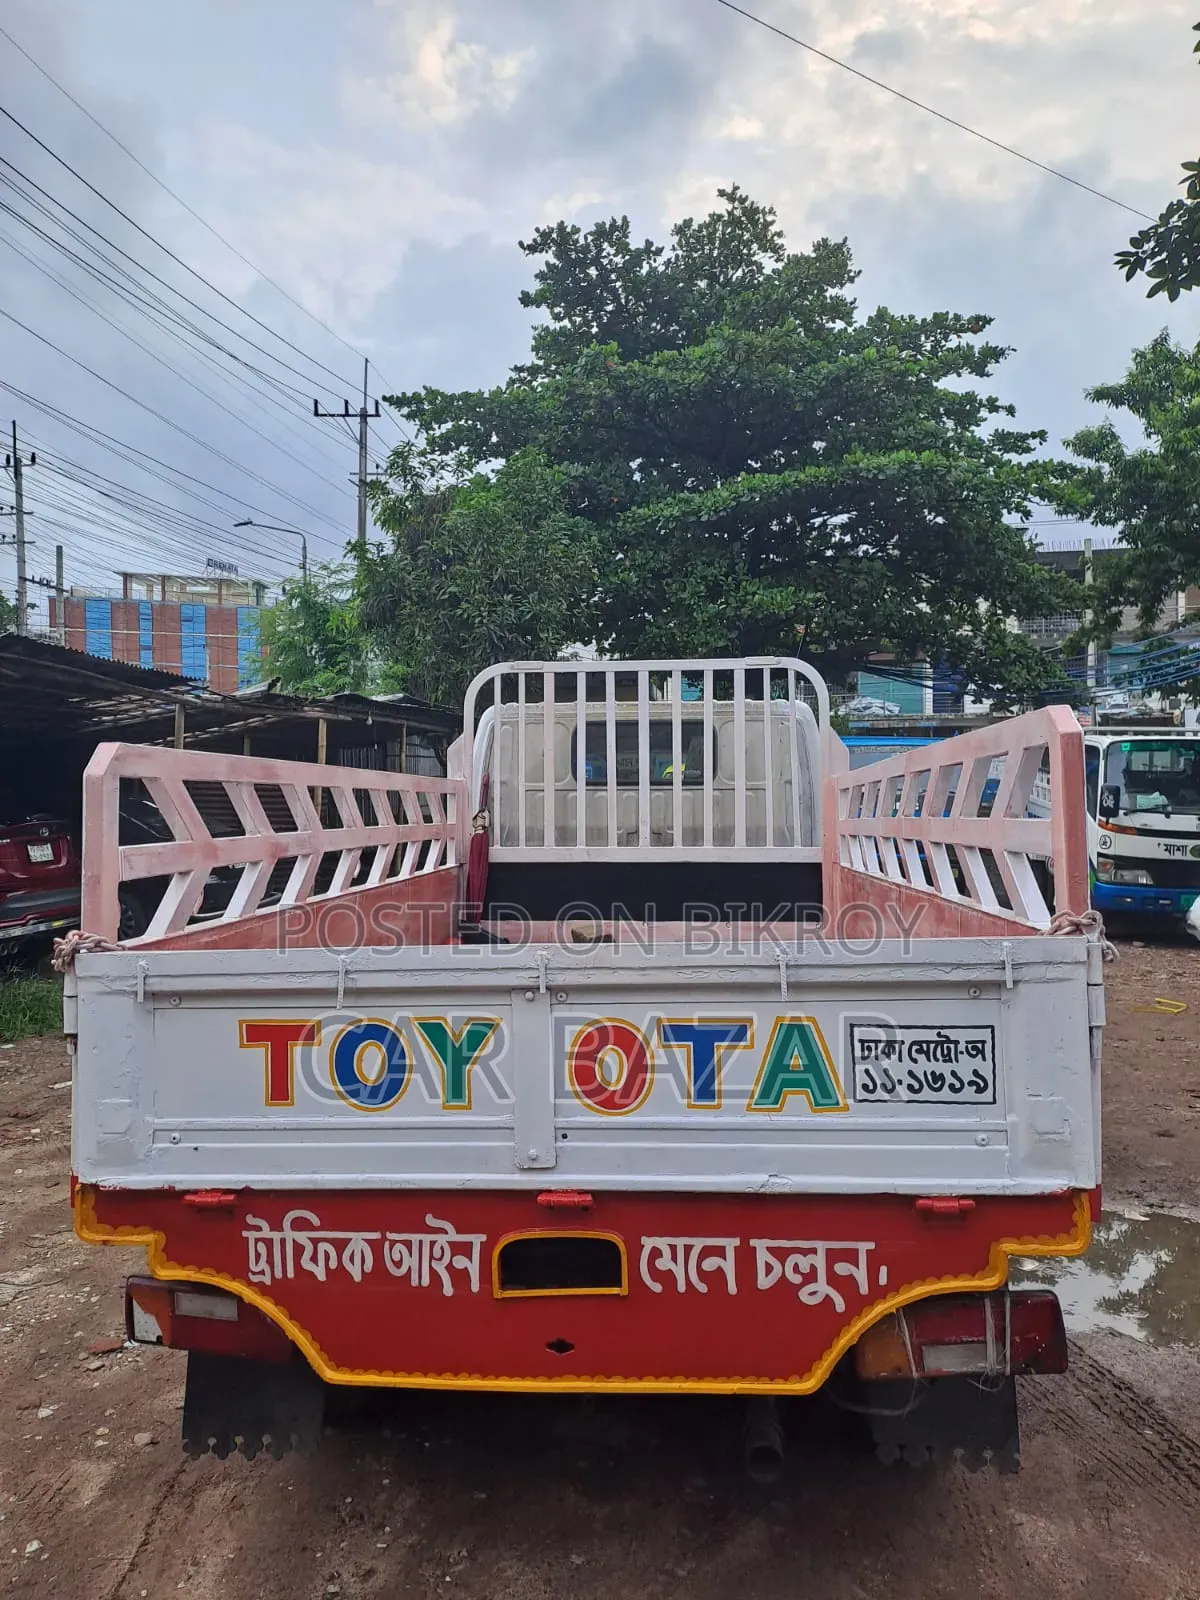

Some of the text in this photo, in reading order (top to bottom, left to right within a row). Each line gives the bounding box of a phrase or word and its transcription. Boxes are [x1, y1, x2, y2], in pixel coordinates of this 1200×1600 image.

[858, 1038, 906, 1063] ঢাকা
[241, 1209, 382, 1286] ট্রাফিক
[383, 1213, 487, 1297] আইন
[639, 1236, 741, 1296] মেনে
